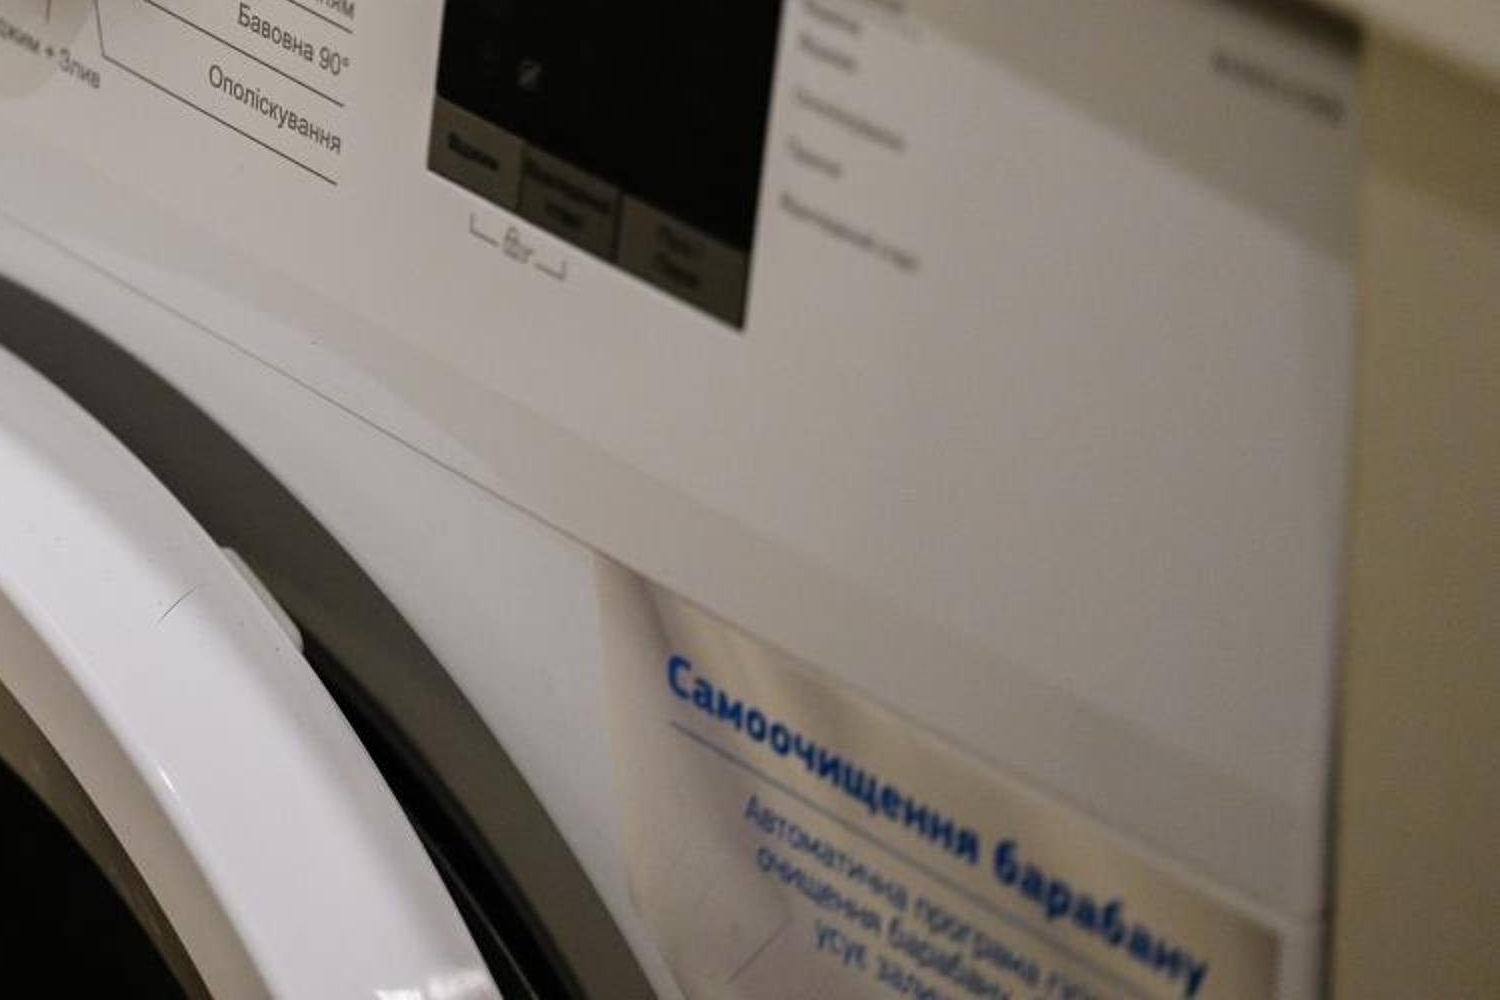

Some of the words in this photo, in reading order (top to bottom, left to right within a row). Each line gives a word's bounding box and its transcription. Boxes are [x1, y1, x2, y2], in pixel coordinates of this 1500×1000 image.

[237, 1, 314, 63] Бавовна
[318, 45, 350, 77] 90°
[208, 63, 342, 155] Ополіскування
[665, 654, 980, 866] Самоочищення
[993, 839, 1209, 1000] барабану
[743, 793, 909, 912] Автоматична
